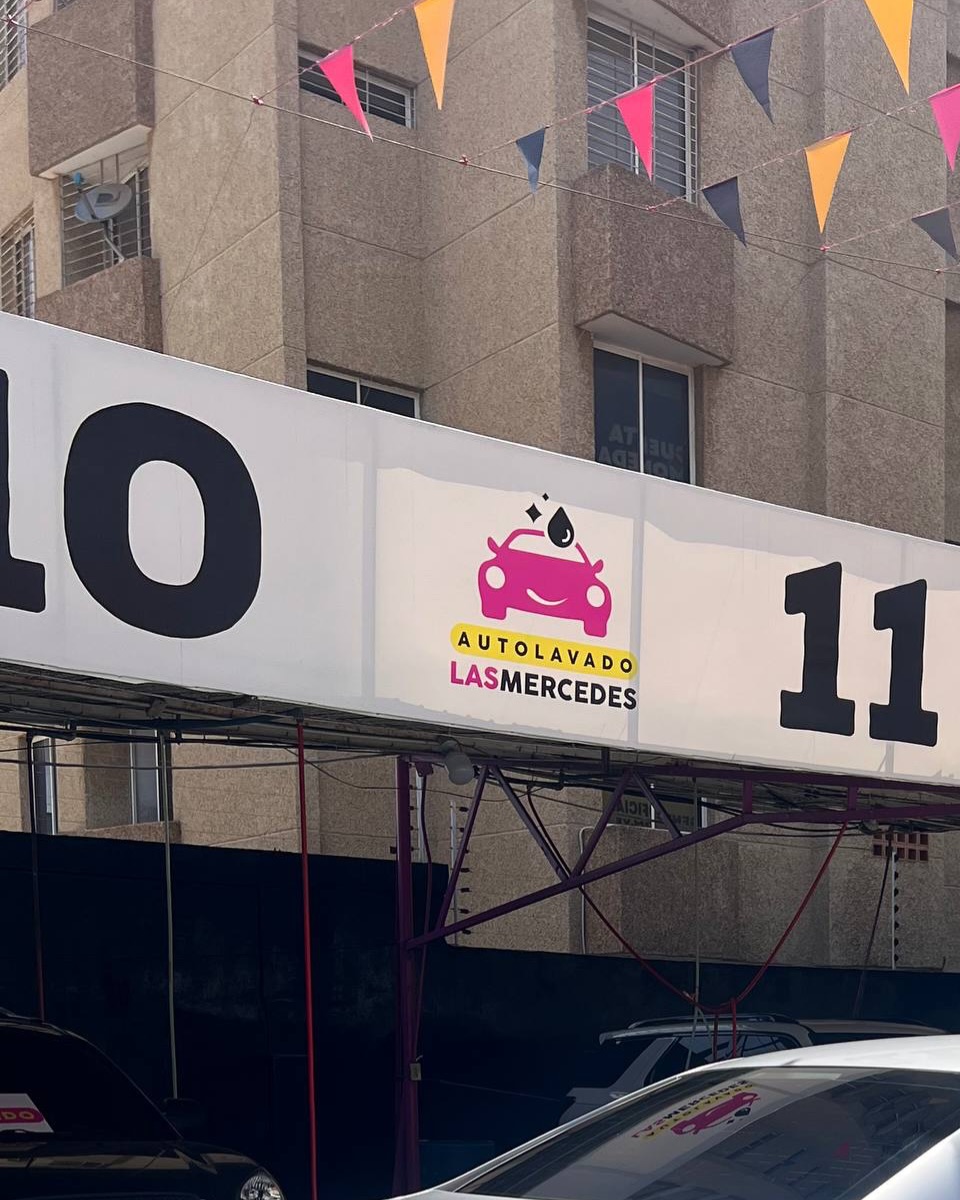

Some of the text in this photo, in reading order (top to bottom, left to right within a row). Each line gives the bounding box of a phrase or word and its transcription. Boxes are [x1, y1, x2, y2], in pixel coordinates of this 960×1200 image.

[458, 631, 633, 673] AUTOLAVADO
[780, 561, 938, 747] 11
[450, 661, 637, 710] LASMERCEDES
[0, 1111, 35, 1120] DO
